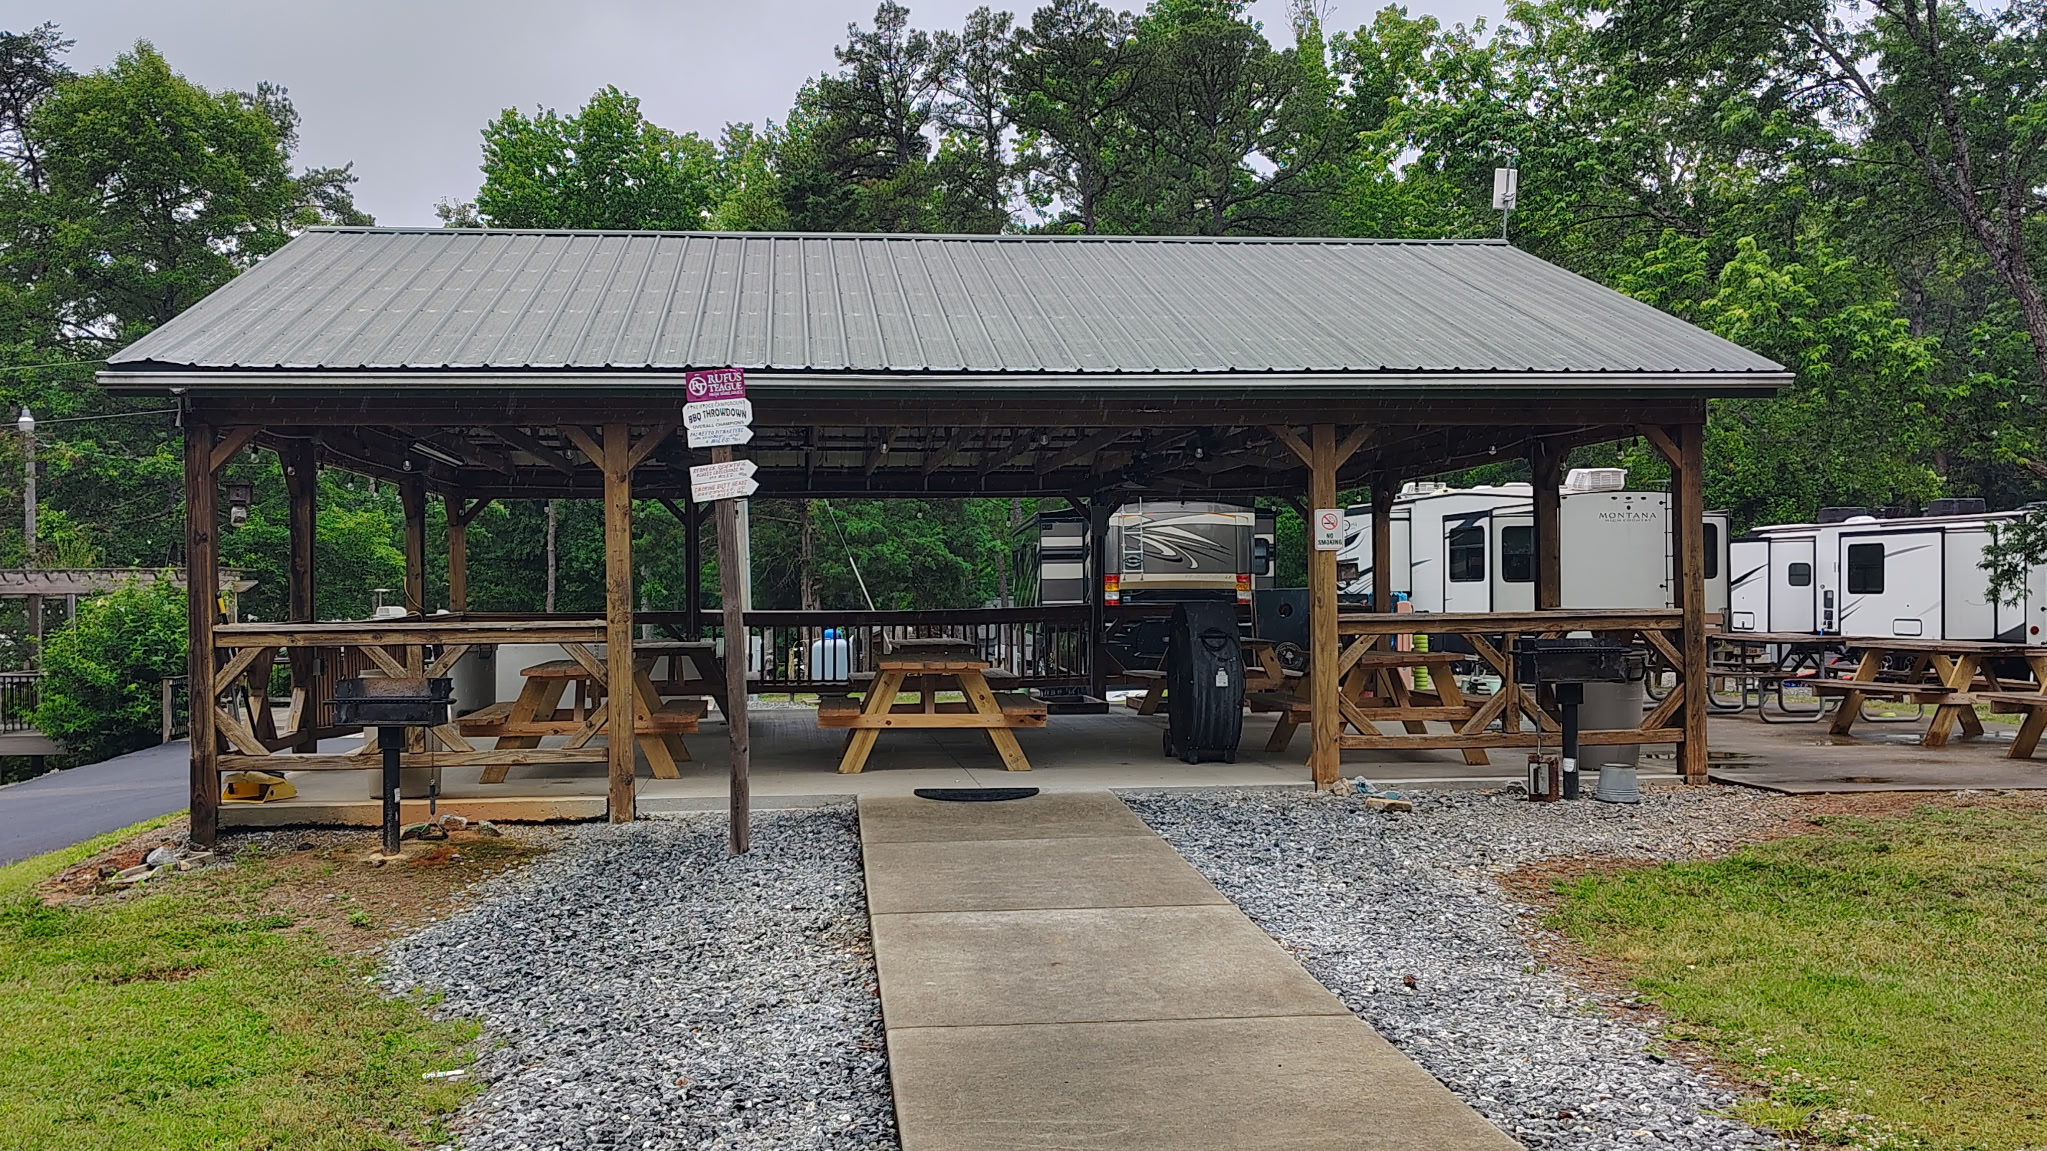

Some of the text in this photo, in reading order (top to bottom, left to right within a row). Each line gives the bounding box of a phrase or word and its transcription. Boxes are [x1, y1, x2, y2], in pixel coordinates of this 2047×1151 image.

[708, 373, 742, 384] RUFUS
[708, 382, 743, 392] TEAGUE
[688, 408, 746, 424] BBQ THROWDOWN
